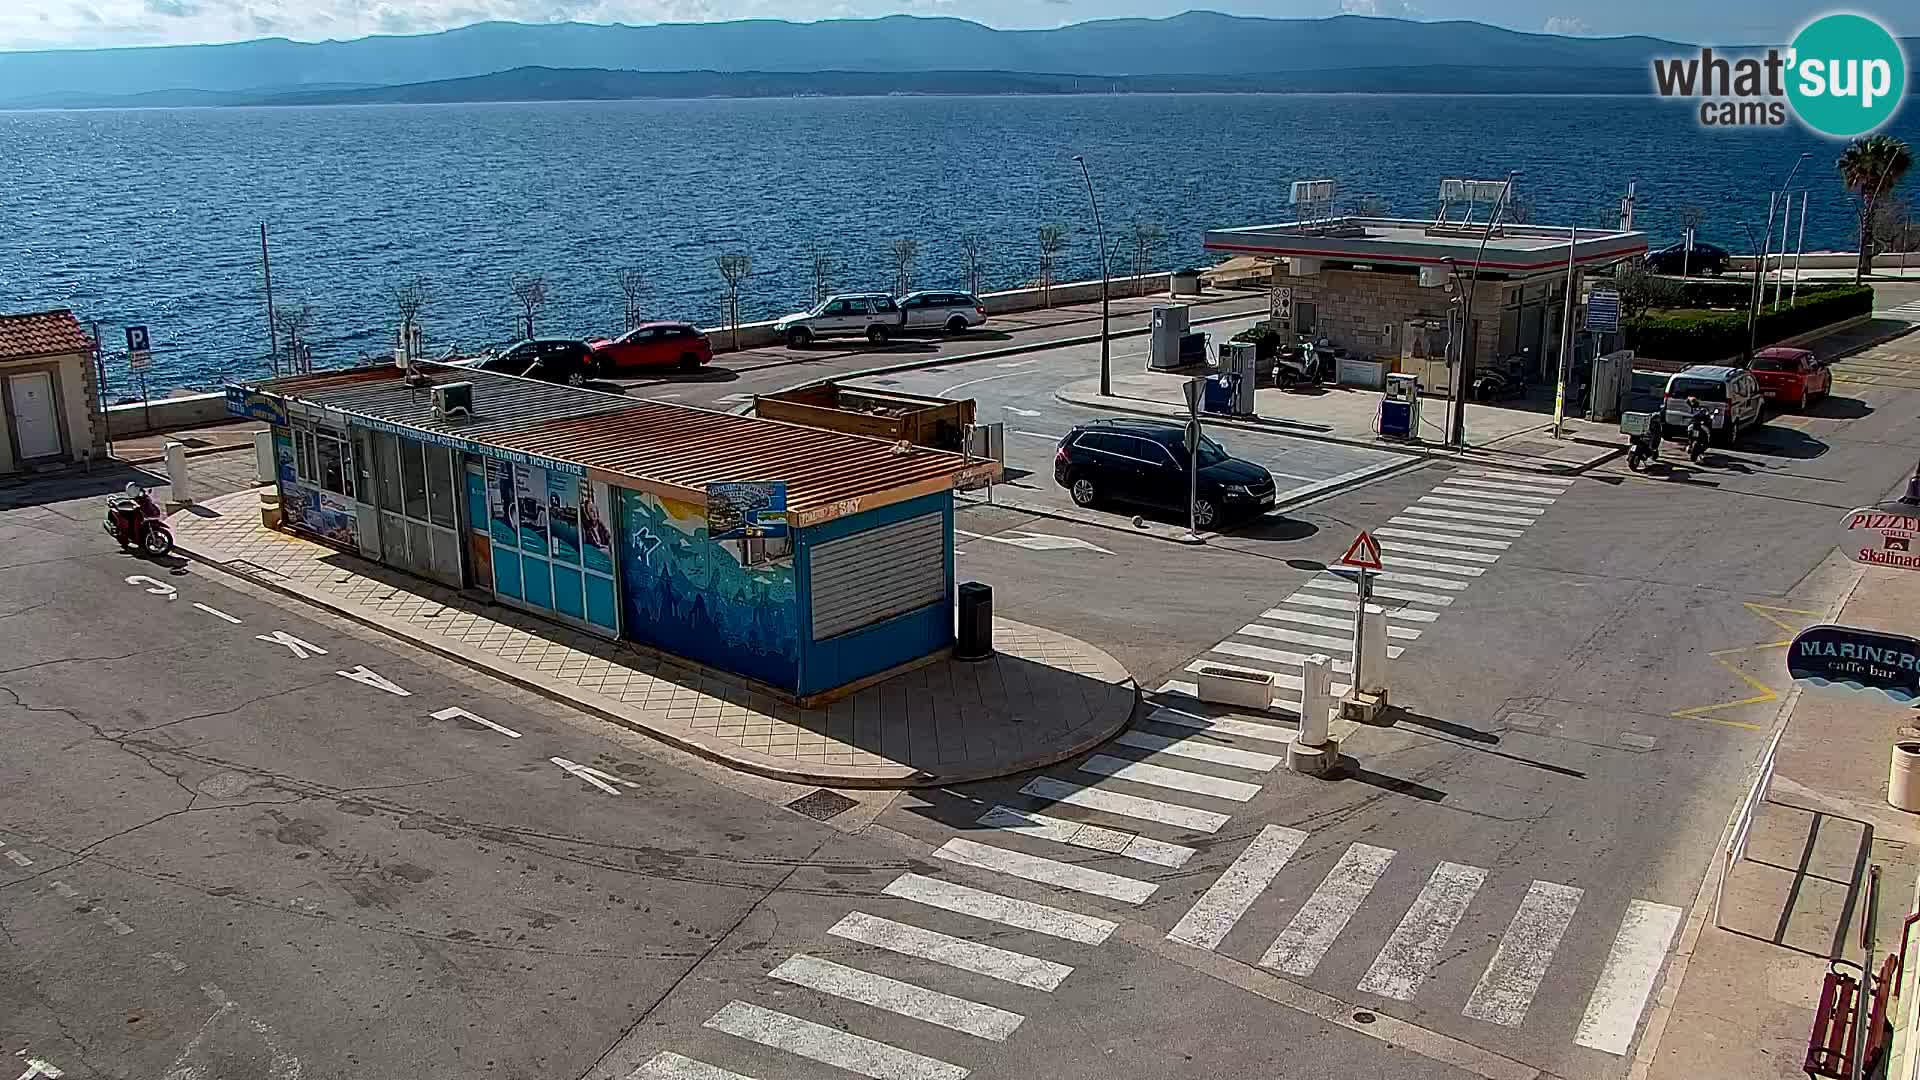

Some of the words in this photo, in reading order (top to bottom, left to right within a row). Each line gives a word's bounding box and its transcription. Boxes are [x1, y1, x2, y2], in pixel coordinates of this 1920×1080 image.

[131, 329, 143, 348] P
[478, 445, 493, 456] BUS
[495, 449, 527, 464] STATION
[530, 455, 554, 469] TICKET
[556, 461, 583, 475] OFFICE
[1848, 514, 1920, 532] PIZZE
[1828, 661, 1865, 673] caffe
[1870, 665, 1896, 679] bar
